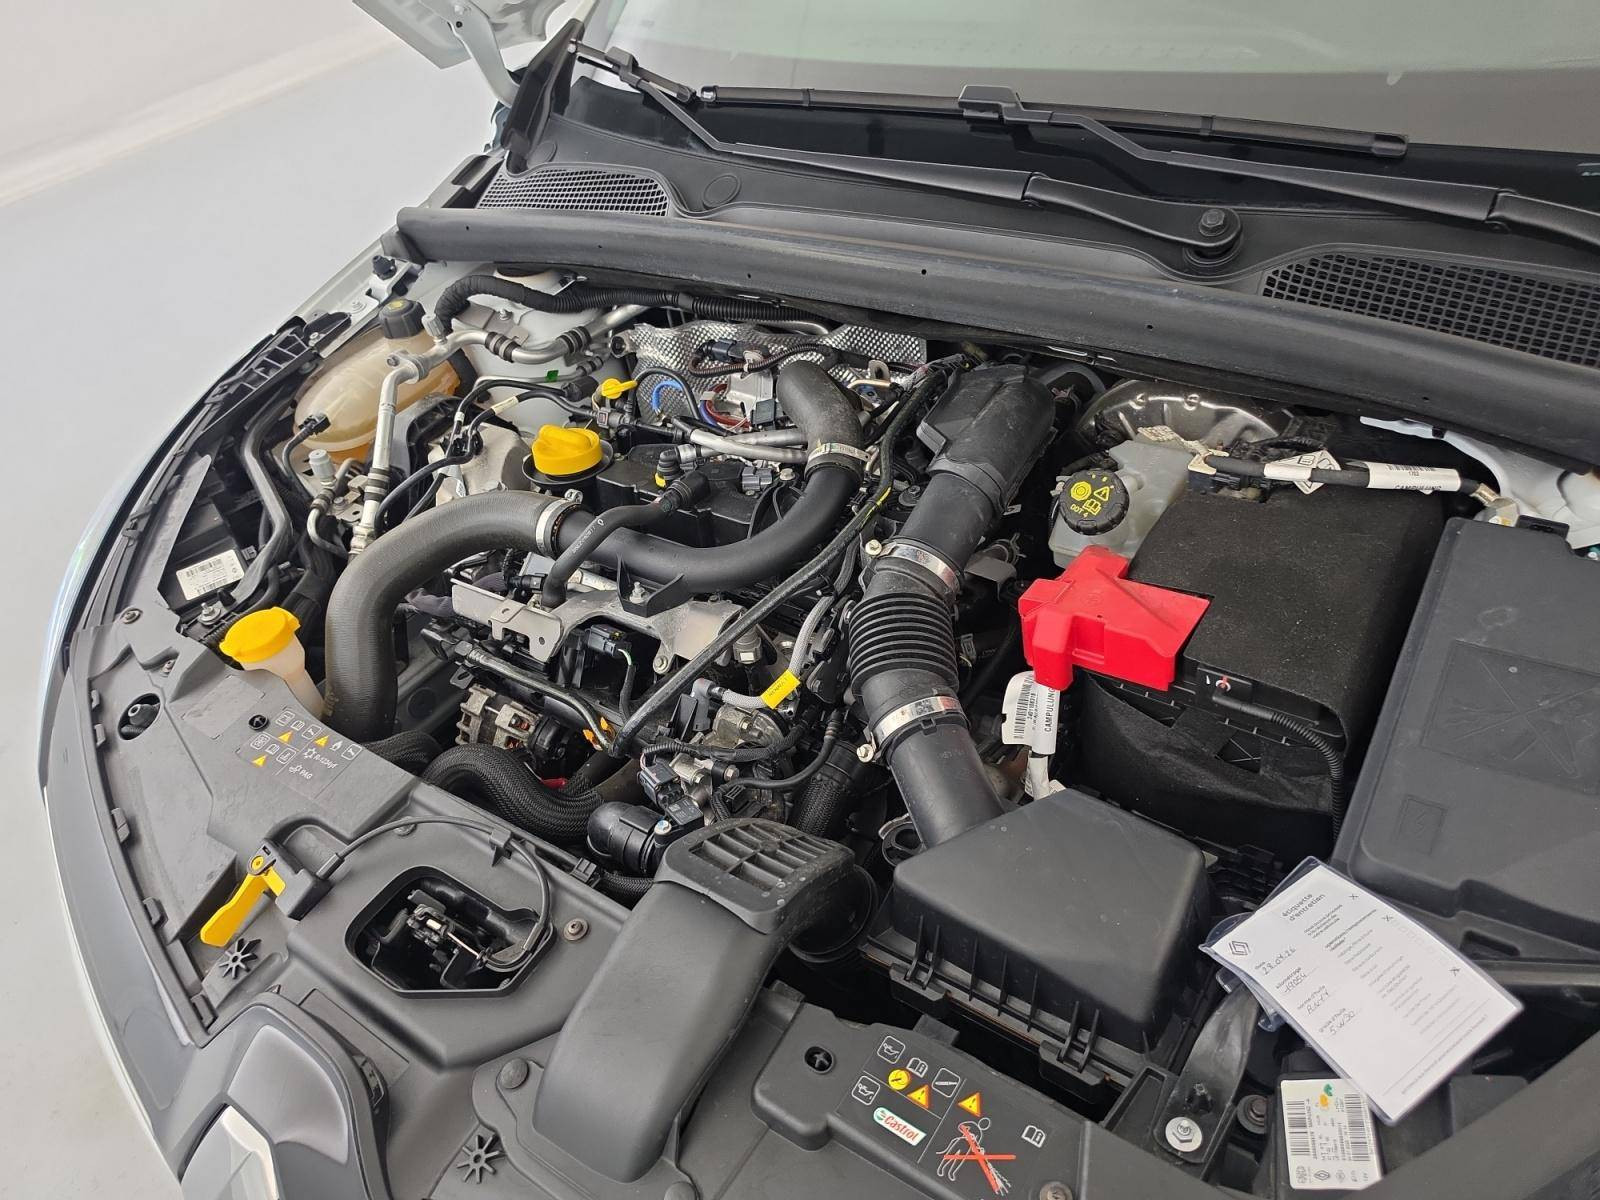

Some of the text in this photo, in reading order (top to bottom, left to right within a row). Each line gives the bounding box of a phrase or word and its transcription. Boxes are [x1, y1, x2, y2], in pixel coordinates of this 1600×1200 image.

[1070, 503, 1084, 514] DOT
[1044, 687, 1056, 732] CAMPULUNG
[884, 1115, 919, 1141] Castrol
